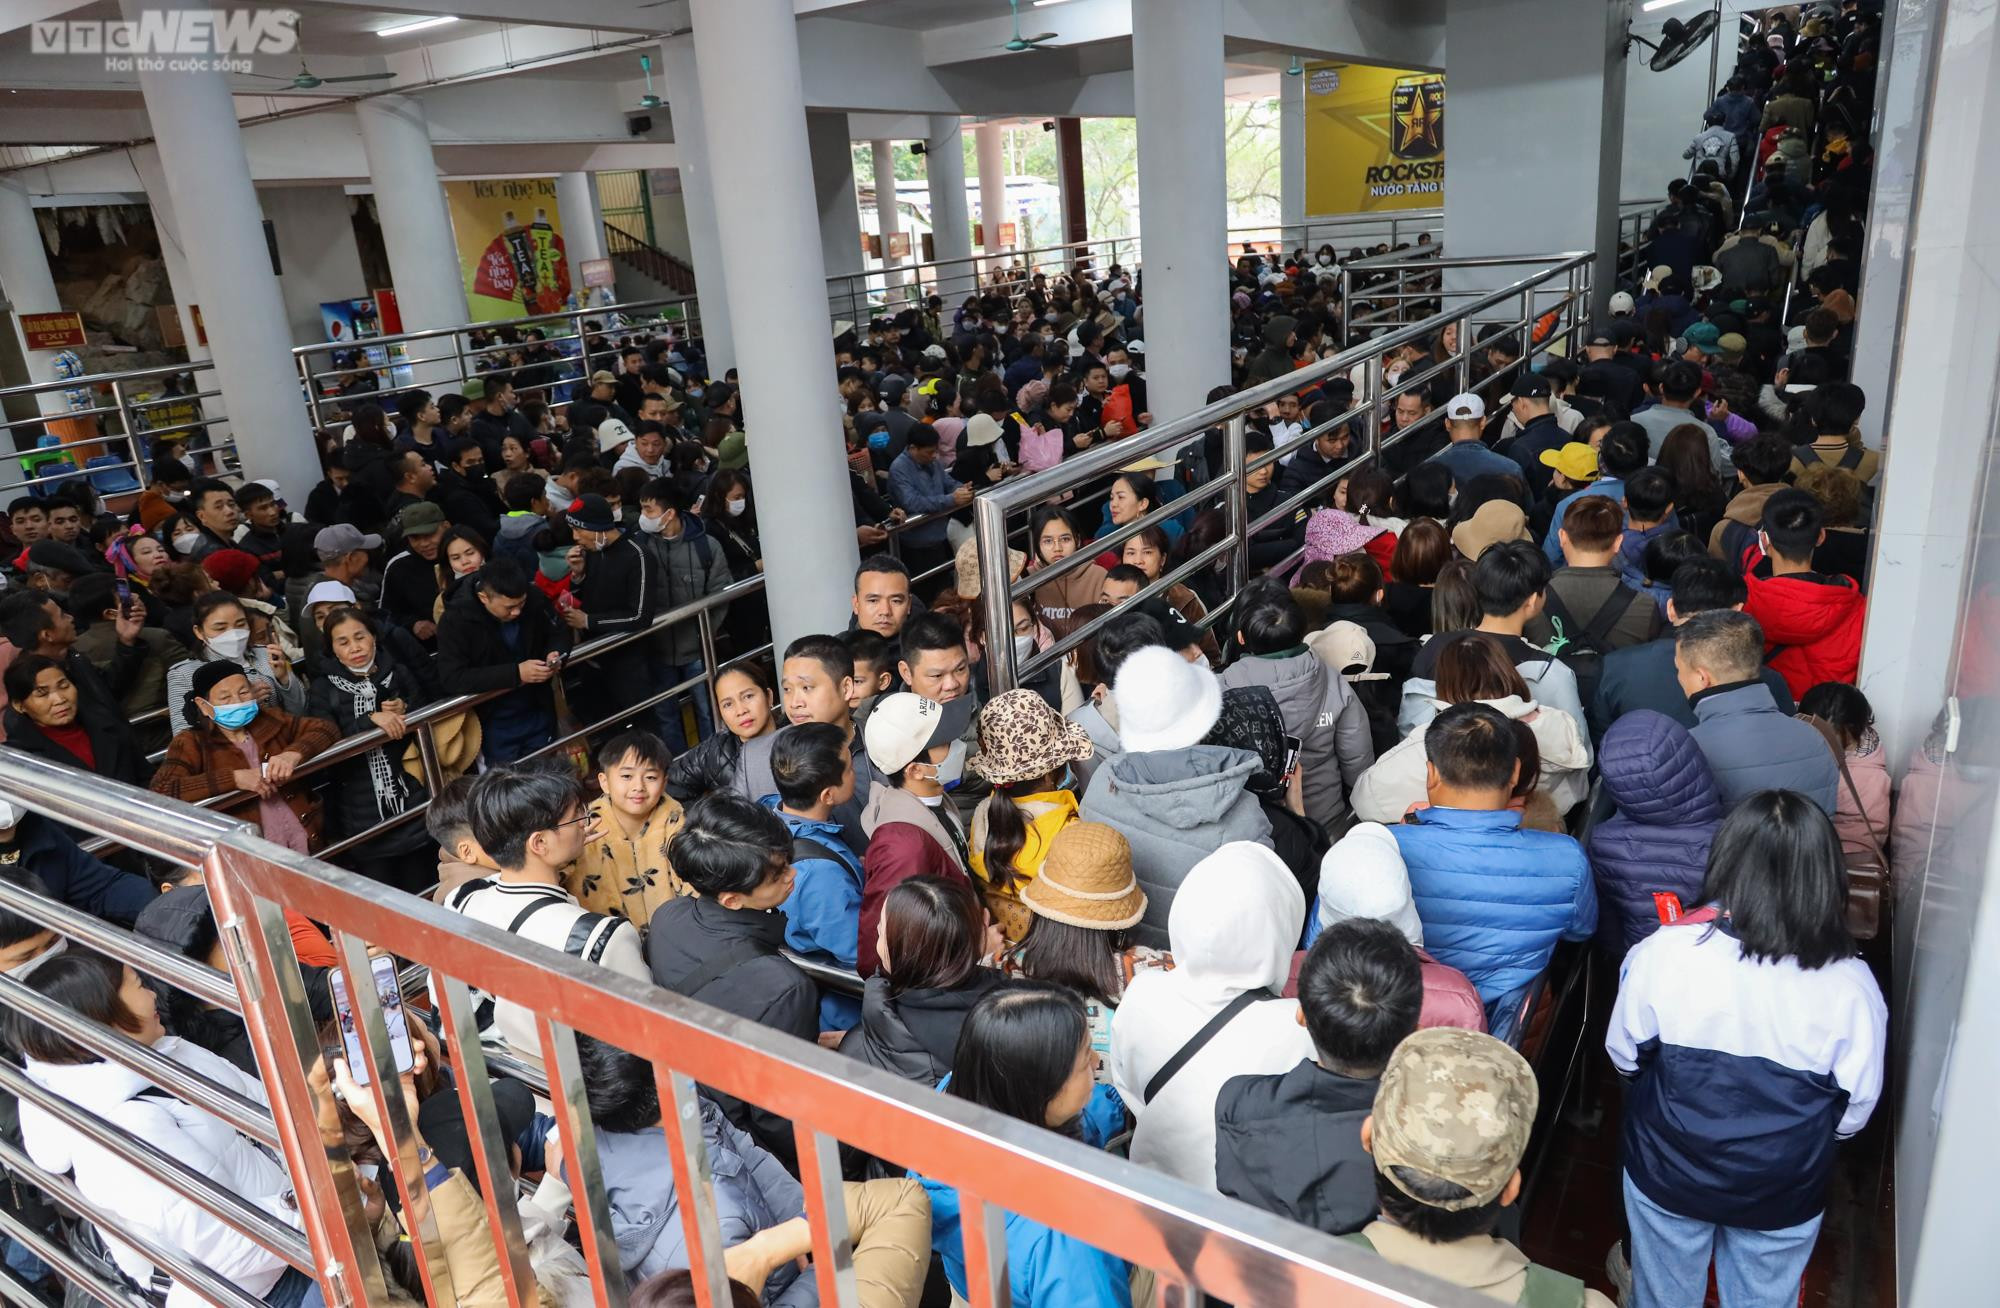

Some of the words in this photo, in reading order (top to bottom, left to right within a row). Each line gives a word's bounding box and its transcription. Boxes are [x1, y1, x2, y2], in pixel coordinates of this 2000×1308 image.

[1407, 180, 1438, 194] TĂNG
[38, 331, 72, 341] EXIT
[1315, 712, 1333, 727] EN
